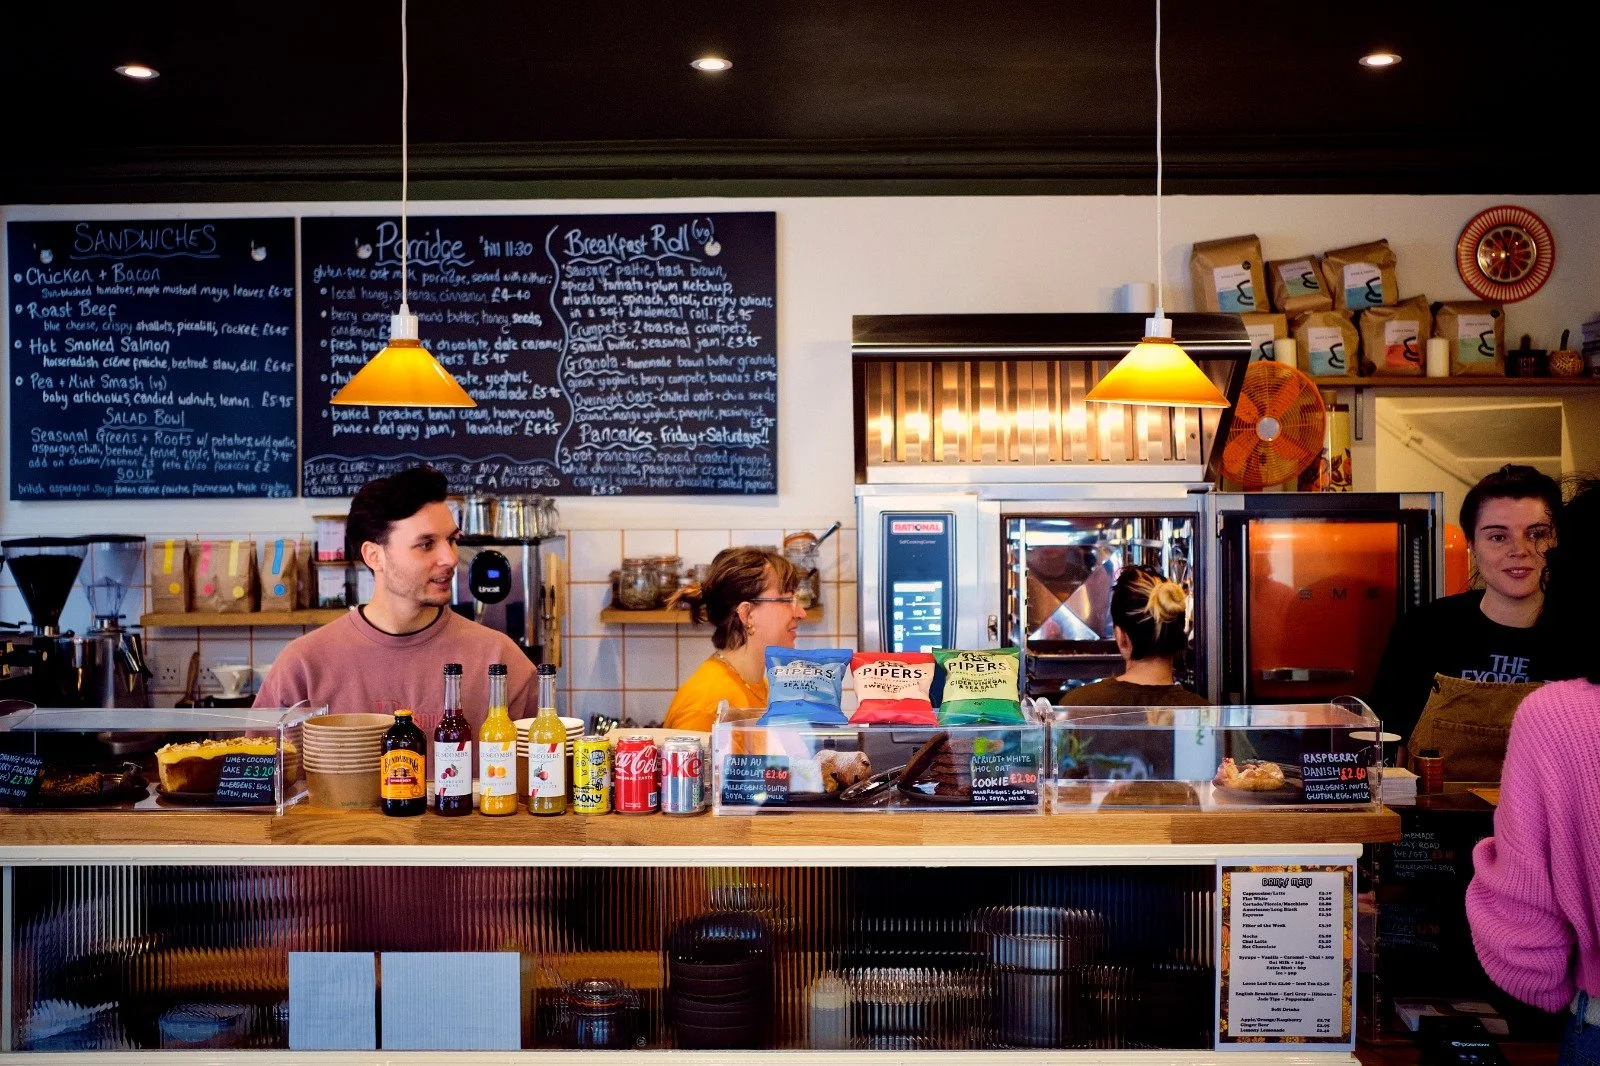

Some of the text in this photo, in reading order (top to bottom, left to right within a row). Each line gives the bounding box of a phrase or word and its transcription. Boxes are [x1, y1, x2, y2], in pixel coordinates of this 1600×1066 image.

[74, 223, 217, 254] SANDWICHES
[563, 228, 649, 261] Breakfast
[650, 223, 690, 254] Roll
[376, 221, 466, 275] Porridge
[26, 267, 93, 286] Chicken
[112, 263, 161, 284] Bacon
[656, 261, 685, 279] hash
[162, 284, 197, 296] mustard
[560, 277, 643, 298] spiced tomato
[702, 293, 737, 311] crispy
[27, 299, 118, 322] Roast Beef
[570, 308, 581, 319] in
[587, 308, 595, 318] a
[599, 306, 624, 321] soft
[44, 321, 61, 332] blue
[102, 321, 133, 335] crispy
[569, 320, 627, 343] Crumpets
[30, 335, 171, 355] Hot Smoked Salmon
[330, 336, 519, 354] fresh date
[641, 336, 691, 350] seasonal
[43, 354, 99, 369] horseradish
[330, 355, 370, 369] peanut
[564, 353, 620, 372] Granola
[30, 372, 53, 390] Pea
[68, 374, 96, 389] Mint
[100, 373, 145, 391] Smash
[640, 372, 666, 391] berry
[42, 390, 69, 411] baby
[133, 391, 174, 405] candied
[103, 407, 148, 426] SALAD
[331, 405, 371, 422] baked
[31, 427, 89, 443] Seasonal
[96, 428, 138, 446] Greens
[154, 431, 192, 448] Roots
[333, 423, 364, 438] prune
[372, 421, 395, 435] earl
[396, 423, 420, 441] grey
[580, 423, 655, 445] Pancakes
[573, 449, 592, 462] oat
[116, 467, 156, 481] SOUP
[948, 661, 1007, 673] PIPERS
[1490, 654, 1530, 676] THE
[775, 668, 834, 679] PIPERS
[863, 667, 922, 679] PIPERS
[247, 756, 276, 765] COCONUT
[726, 757, 762, 767] PAIN AU
[1006, 754, 1031, 763] WHITE
[1303, 753, 1359, 764] RASPBERRY
[222, 765, 274, 777] CAKE £3.20
[724, 767, 765, 779] CHOCOLAT
[970, 764, 1011, 773] CHOC OAT
[1303, 766, 1367, 780] DANISH £2.60
[220, 781, 256, 790] ALLERGENS:
[972, 772, 1037, 788] COOKIE £2.80
[1305, 783, 1348, 792] ALLERGENS:
[242, 791, 259, 799] MILK
[1352, 791, 1370, 799] MILK
[1290, 877, 1313, 889] MENU
